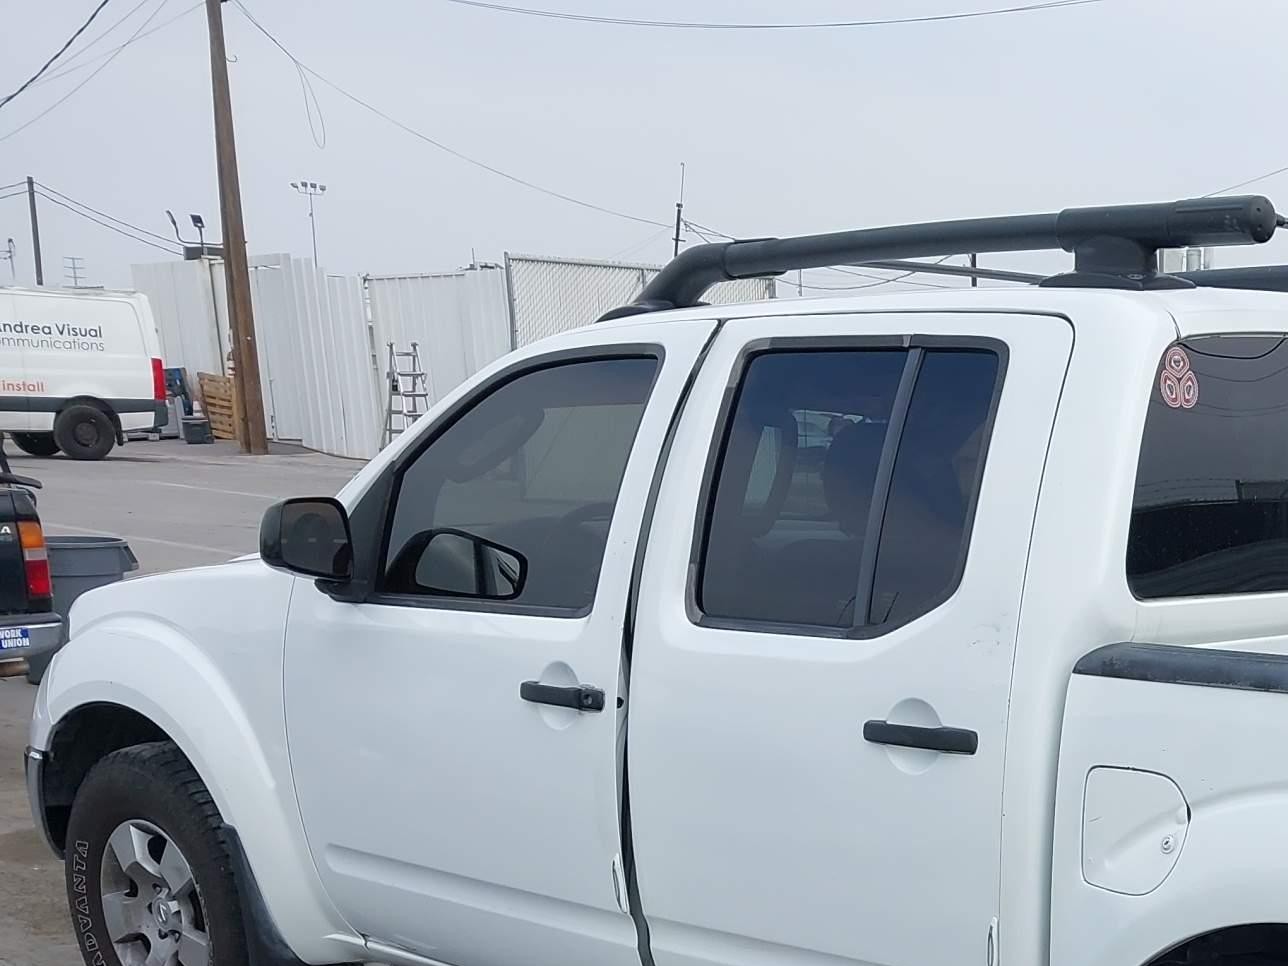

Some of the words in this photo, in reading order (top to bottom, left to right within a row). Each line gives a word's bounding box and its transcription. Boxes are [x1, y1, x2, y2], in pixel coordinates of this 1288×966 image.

[0, 321, 52, 335] ndrea
[55, 323, 103, 338] Visual
[0, 337, 105, 352] mmunications
[2, 380, 45, 392] install
[1, 637, 30, 649] UNION
